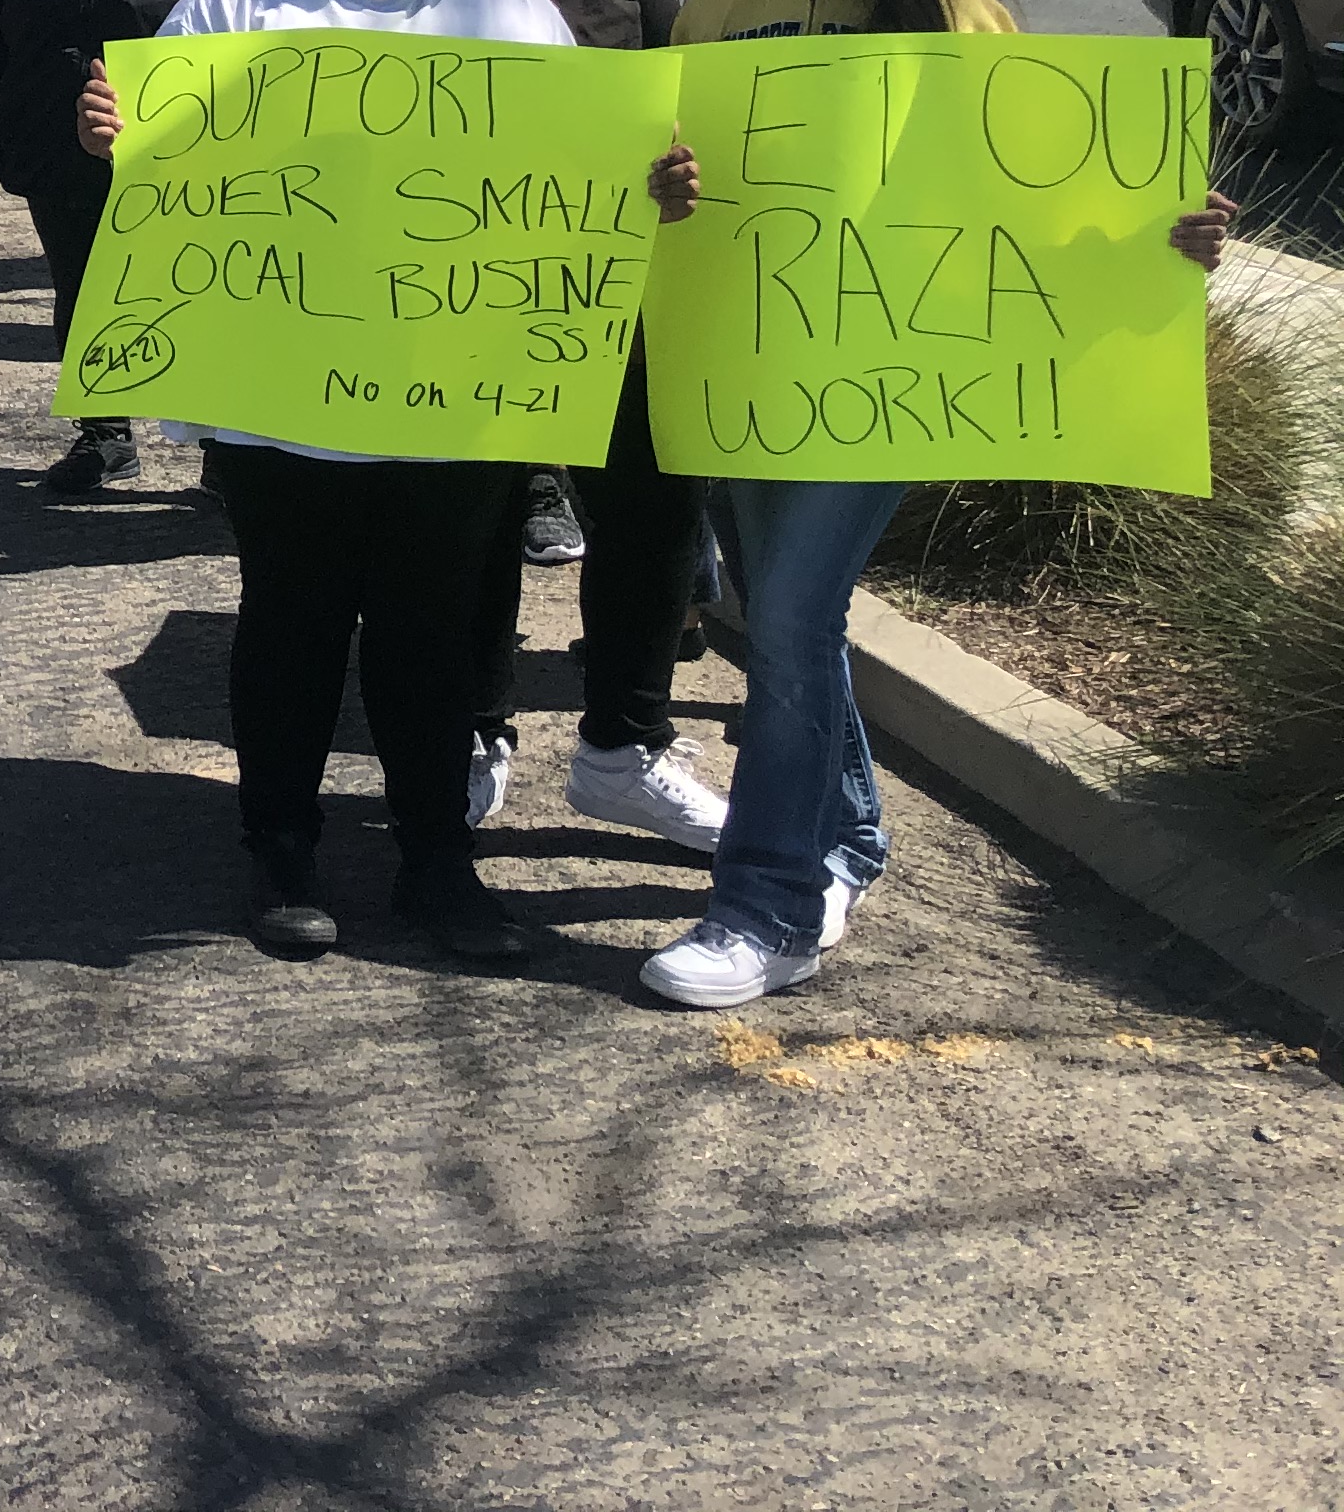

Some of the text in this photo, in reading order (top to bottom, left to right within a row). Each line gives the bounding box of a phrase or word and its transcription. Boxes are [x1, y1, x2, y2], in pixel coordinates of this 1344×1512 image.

[136, 45, 547, 160] SUPPORT
[700, 52, 1211, 206] ET OUR
[111, 164, 647, 243] OWER SMALL
[113, 240, 649, 322] LOCAL BUSINE
[734, 206, 1065, 354] RAZA
[325, 368, 380, 405] No
[474, 380, 560, 417] 4-21
